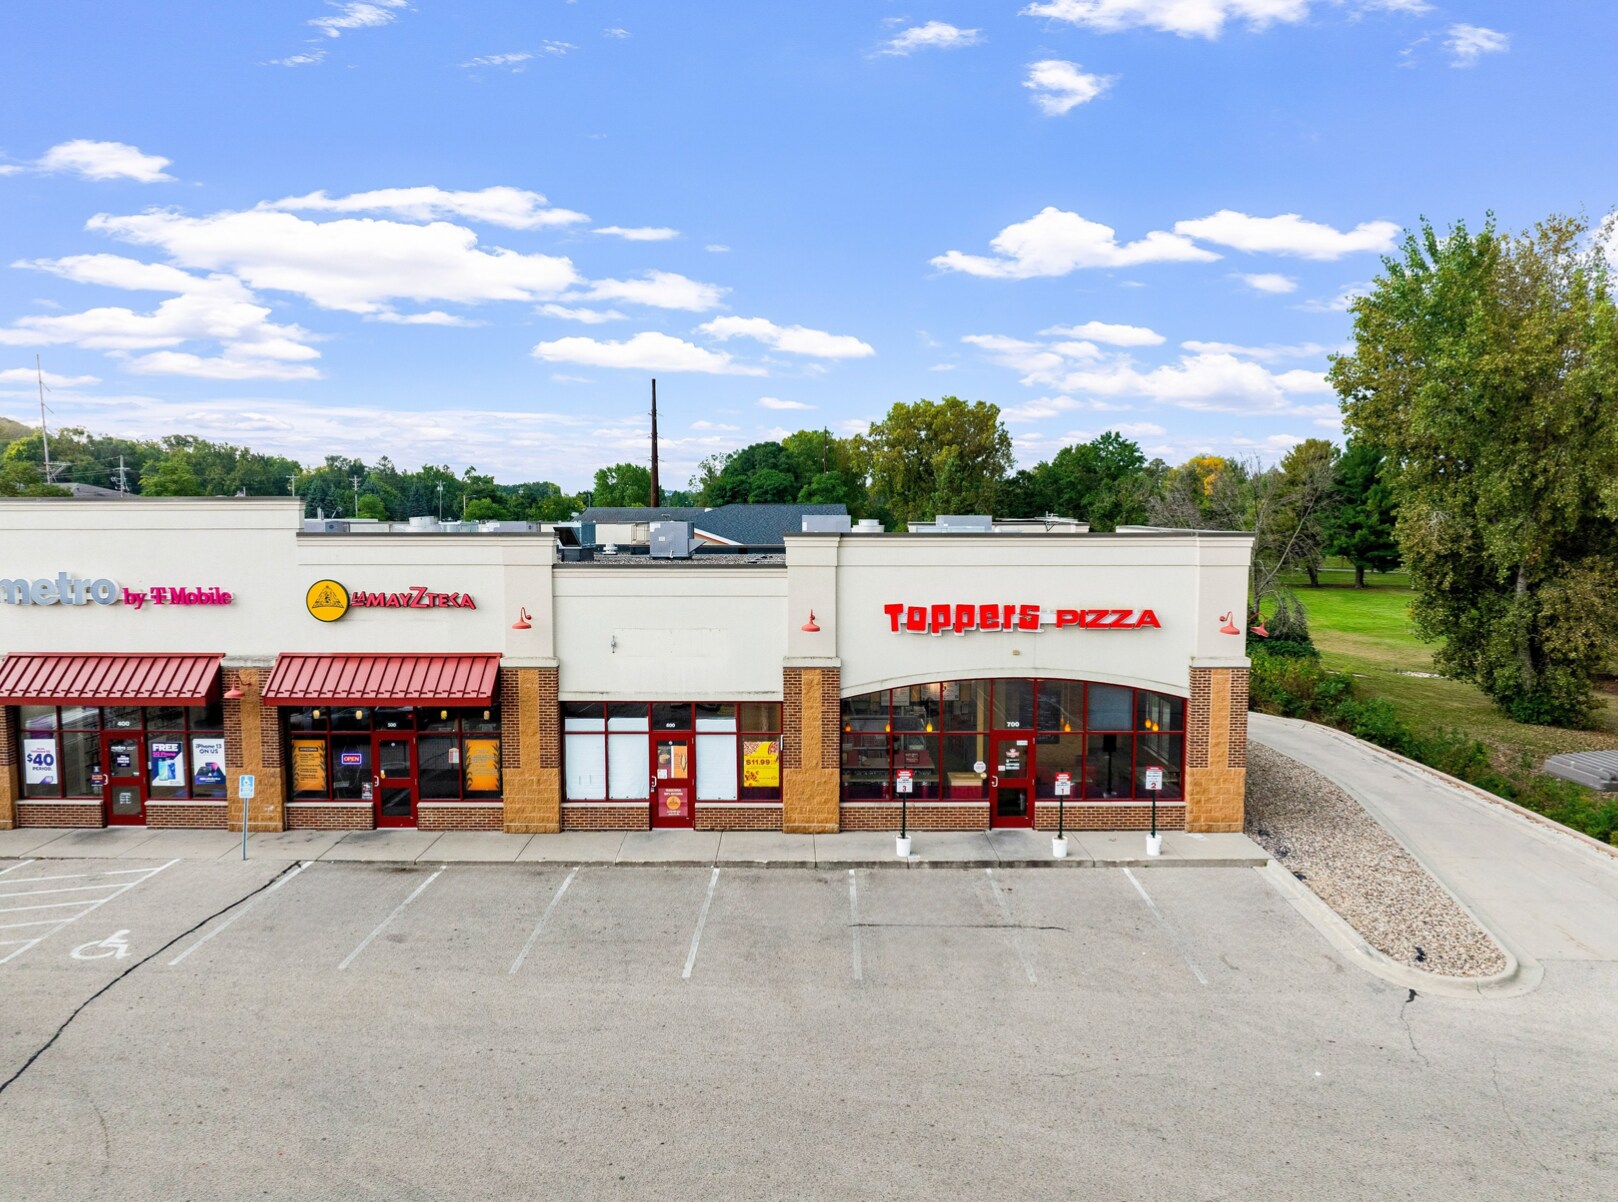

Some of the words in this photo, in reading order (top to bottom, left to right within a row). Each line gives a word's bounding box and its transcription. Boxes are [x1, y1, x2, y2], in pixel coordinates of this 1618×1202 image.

[0, 572, 118, 605] metro
[122, 587, 147, 609] by
[351, 591, 366, 606] LA
[365, 587, 477, 610] MAYZTECA
[884, 603, 1043, 636] Toppers
[1056, 609, 1161, 629] PIZZA
[152, 743, 179, 752] FREE
[27, 753, 54, 767] $40
